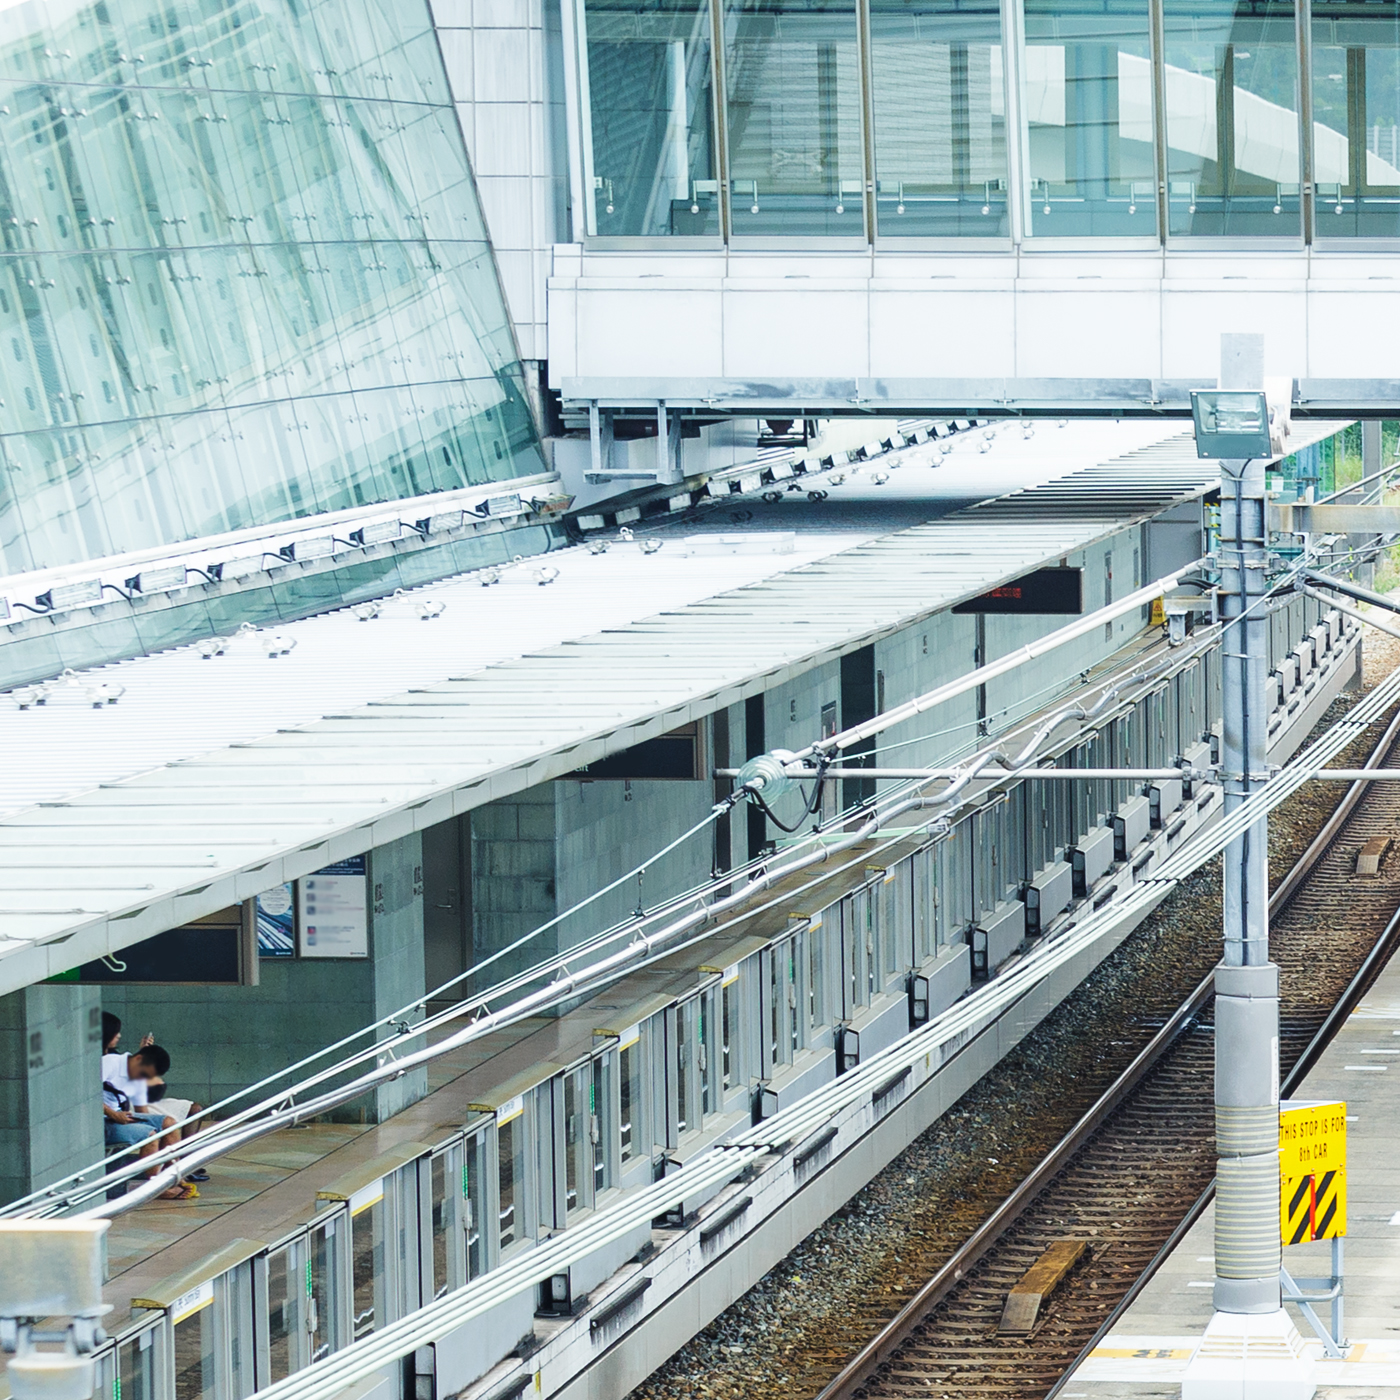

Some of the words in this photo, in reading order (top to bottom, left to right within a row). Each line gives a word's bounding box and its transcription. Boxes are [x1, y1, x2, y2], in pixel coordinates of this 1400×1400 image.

[1280, 1124, 1297, 1141] THIS
[1300, 1120, 1318, 1138] STOP
[1322, 1118, 1328, 1134] IS
[1331, 1116, 1345, 1132] FOR
[1299, 1146, 1310, 1162] 8th
[1314, 1143, 1328, 1159] CAR
